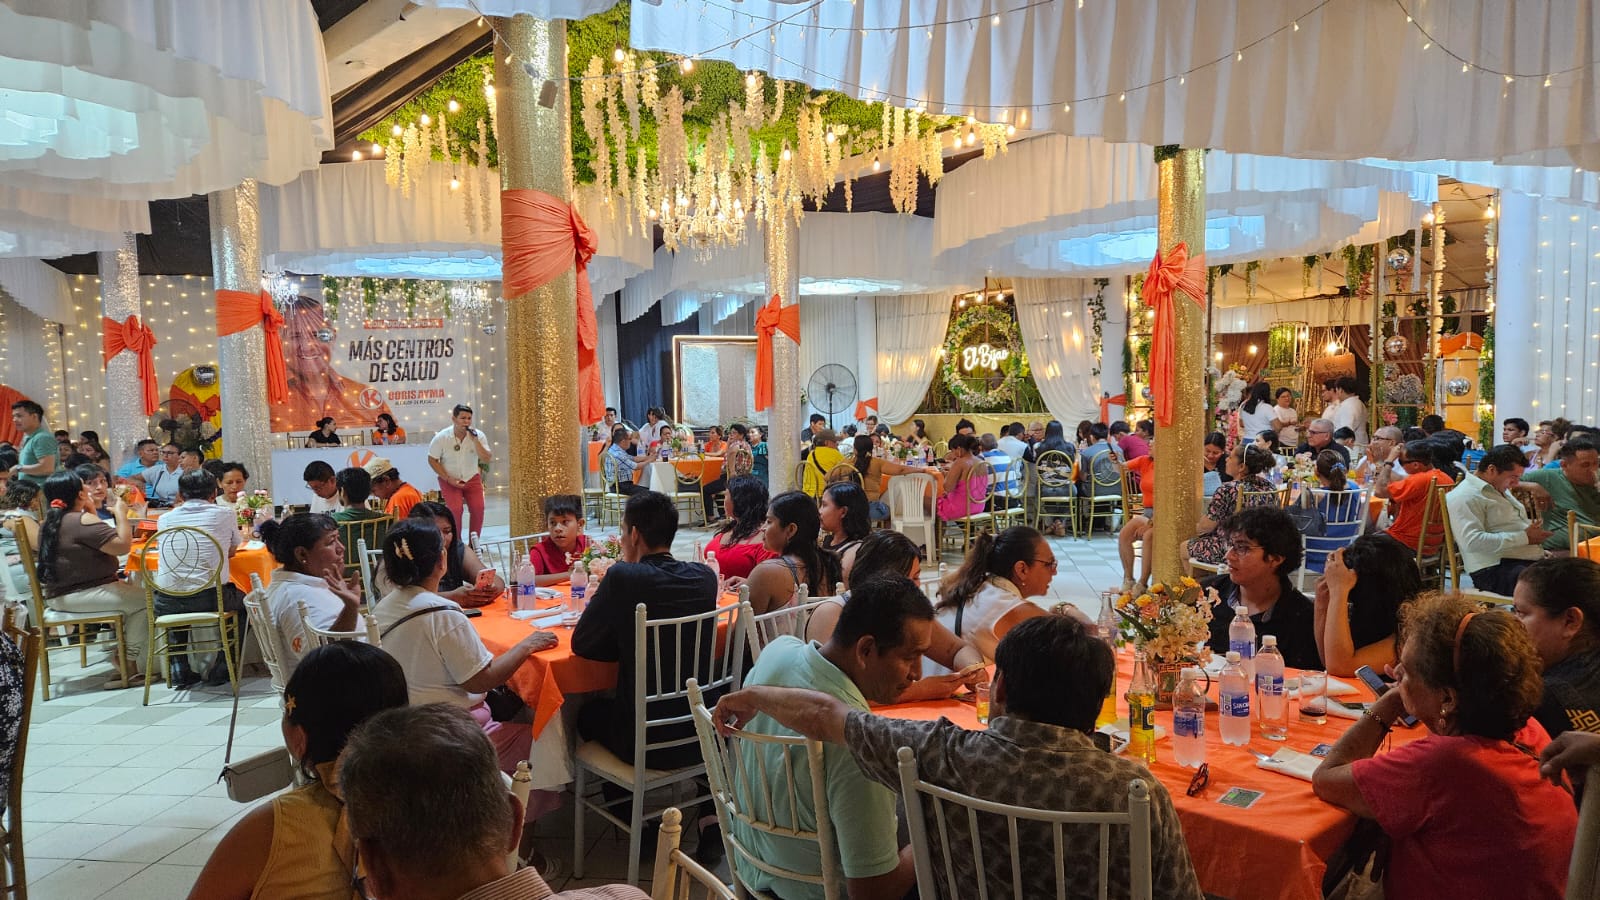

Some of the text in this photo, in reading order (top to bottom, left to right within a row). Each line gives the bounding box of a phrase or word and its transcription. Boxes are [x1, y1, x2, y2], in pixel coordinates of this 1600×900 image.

[349, 335, 454, 361] MÁS CENTROS
[962, 346, 979, 370] El
[369, 361, 439, 382] DE SALUD
